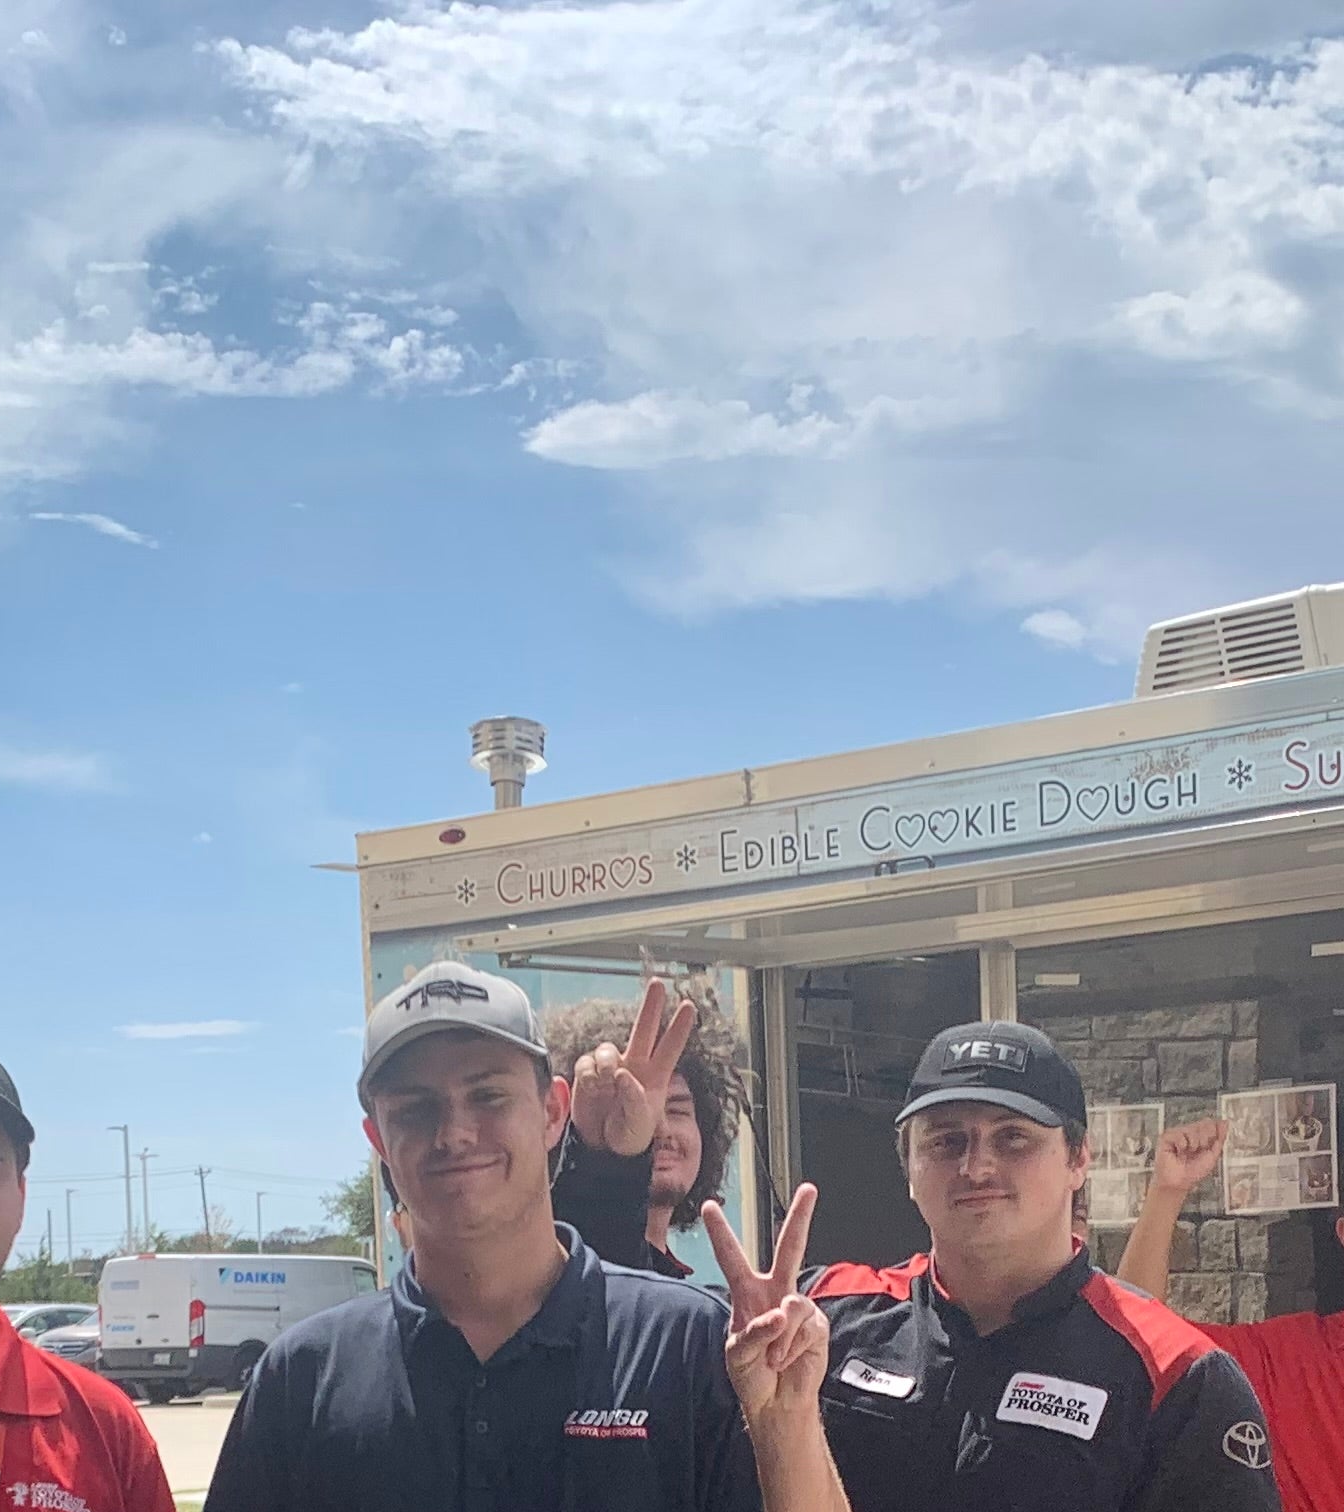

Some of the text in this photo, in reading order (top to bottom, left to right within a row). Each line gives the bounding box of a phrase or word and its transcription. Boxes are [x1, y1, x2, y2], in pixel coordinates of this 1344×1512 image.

[497, 854, 654, 904] CHURROS
[721, 828, 840, 874] EDIBLE
[860, 801, 1017, 851] COOKIE
[1039, 773, 1197, 827] DOUGH
[233, 1271, 286, 1284] DAIKIN
[1011, 1388, 1087, 1410] TOYOTA OF
[565, 1409, 649, 1427] LONGO
[1005, 1398, 1090, 1426] PROSPER
